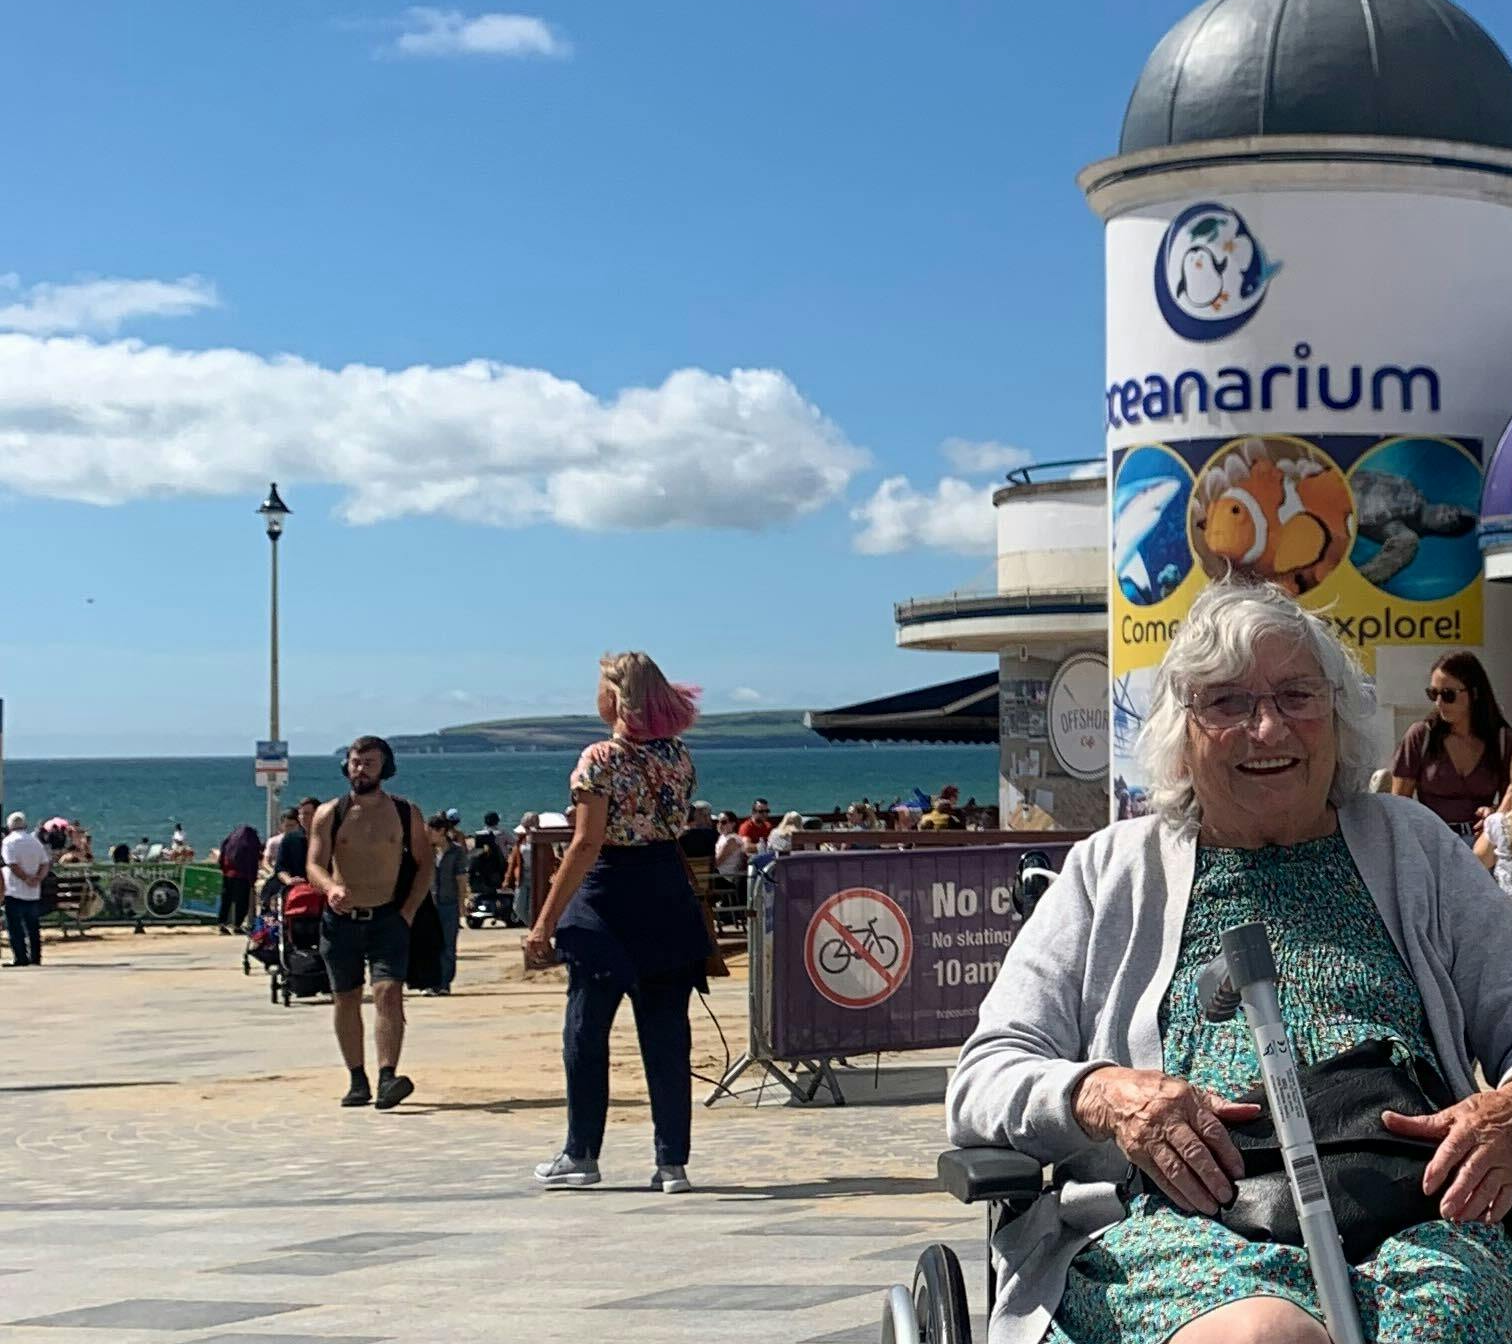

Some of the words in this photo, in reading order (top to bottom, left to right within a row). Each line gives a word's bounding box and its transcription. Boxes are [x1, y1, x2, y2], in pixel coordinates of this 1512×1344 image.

[1105, 342, 1440, 430] ceanarium
[1061, 709, 1109, 734] OFFSHOR
[932, 881, 978, 918] No
[932, 932, 953, 949] No
[957, 927, 1012, 947] skating
